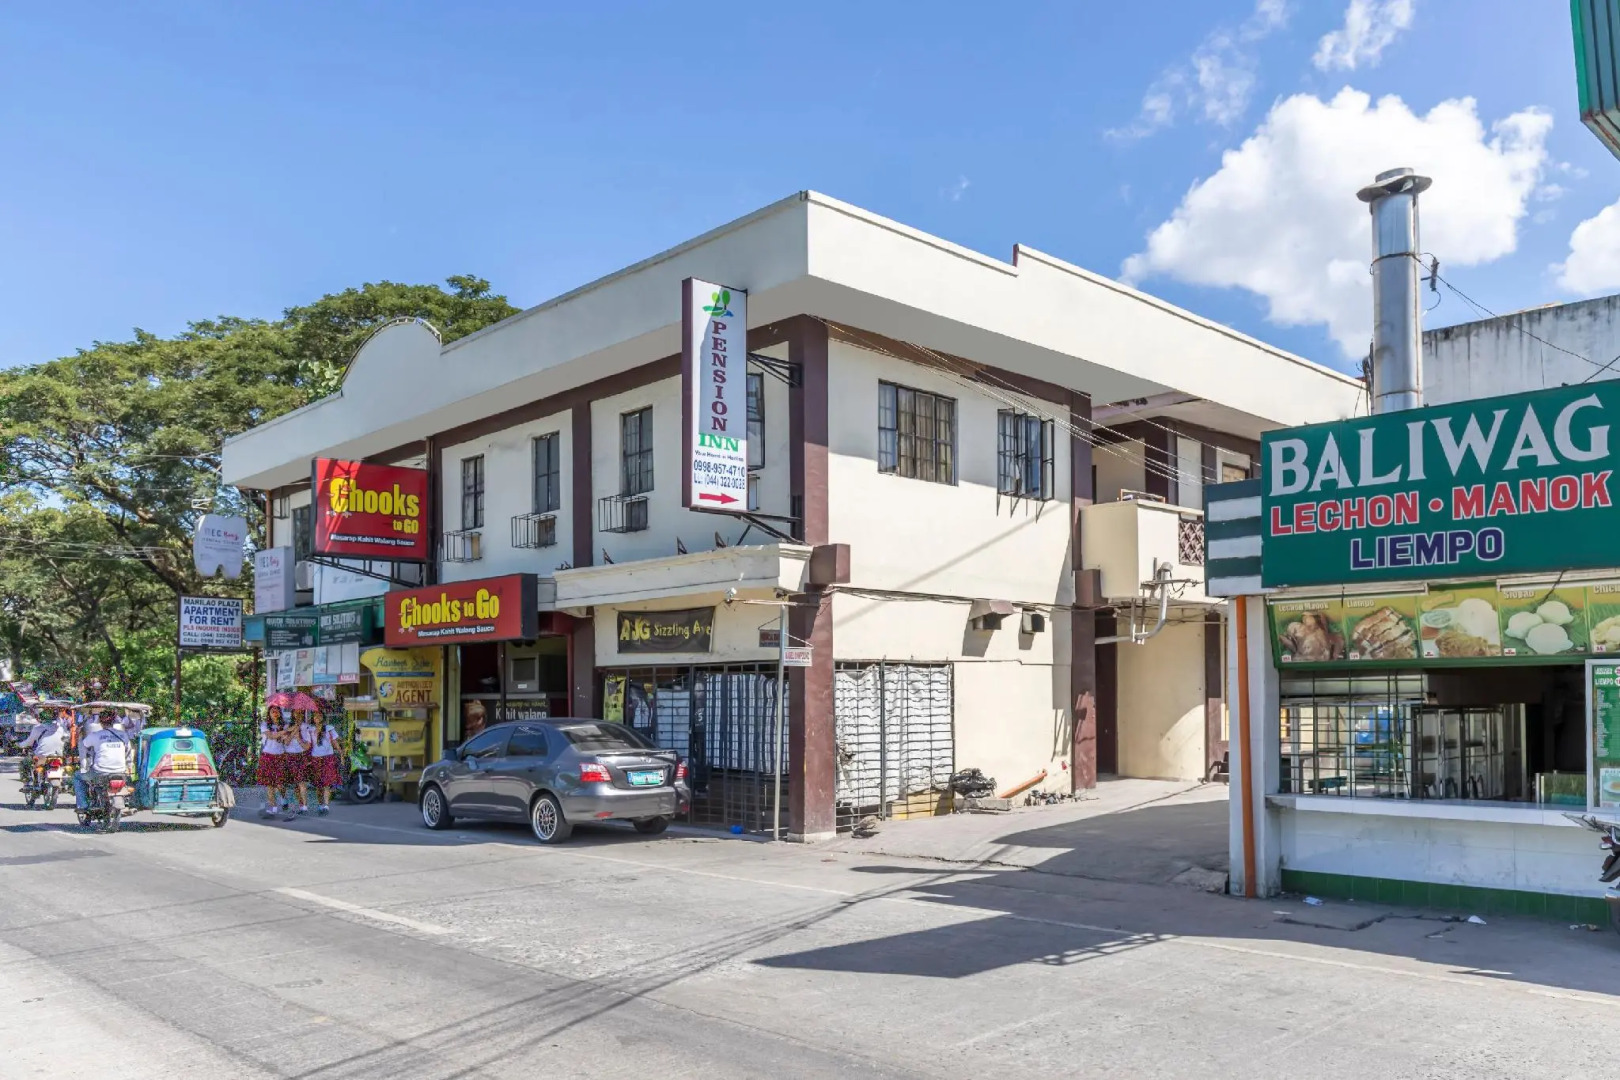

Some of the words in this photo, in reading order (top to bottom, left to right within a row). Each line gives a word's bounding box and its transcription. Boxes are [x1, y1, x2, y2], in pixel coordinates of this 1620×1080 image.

[711, 320, 728, 431] PENSION
[698, 432, 739, 452] INN
[1268, 392, 1611, 497] BALIWAG
[329, 477, 420, 518] Chooks
[1270, 491, 1420, 537] LECHON
[1451, 469, 1613, 521] MANOK
[393, 519, 403, 531] to
[1350, 527, 1506, 571] LIEMPO
[184, 598, 216, 606] MARILAO
[1503, 590, 1536, 600] Siopao
[183, 606, 240, 617] APARTMENT
[400, 592, 461, 629] Chooks
[463, 601, 475, 617] to
[476, 588, 500, 619] Go
[189, 615, 208, 625] FOR
[210, 616, 235, 626] RENT
[476, 625, 495, 633] Sauce
[653, 622, 690, 640] Sizzling
[395, 689, 432, 703] AGENT
[495, 708, 517, 720] Khit
